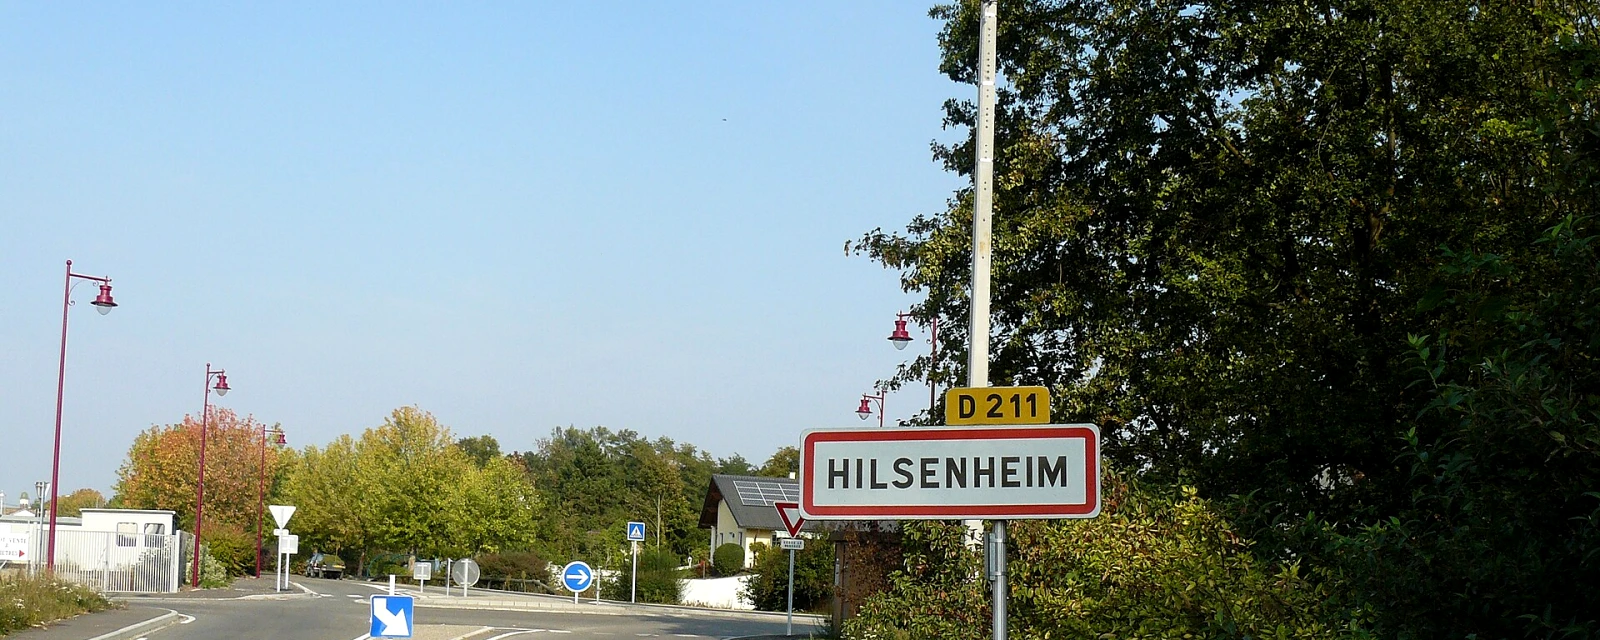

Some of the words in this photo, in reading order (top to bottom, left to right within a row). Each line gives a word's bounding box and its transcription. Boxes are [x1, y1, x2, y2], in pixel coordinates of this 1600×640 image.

[958, 394, 976, 419] D
[986, 392, 1037, 418] 211
[827, 455, 1068, 490] HILSENHEIM
